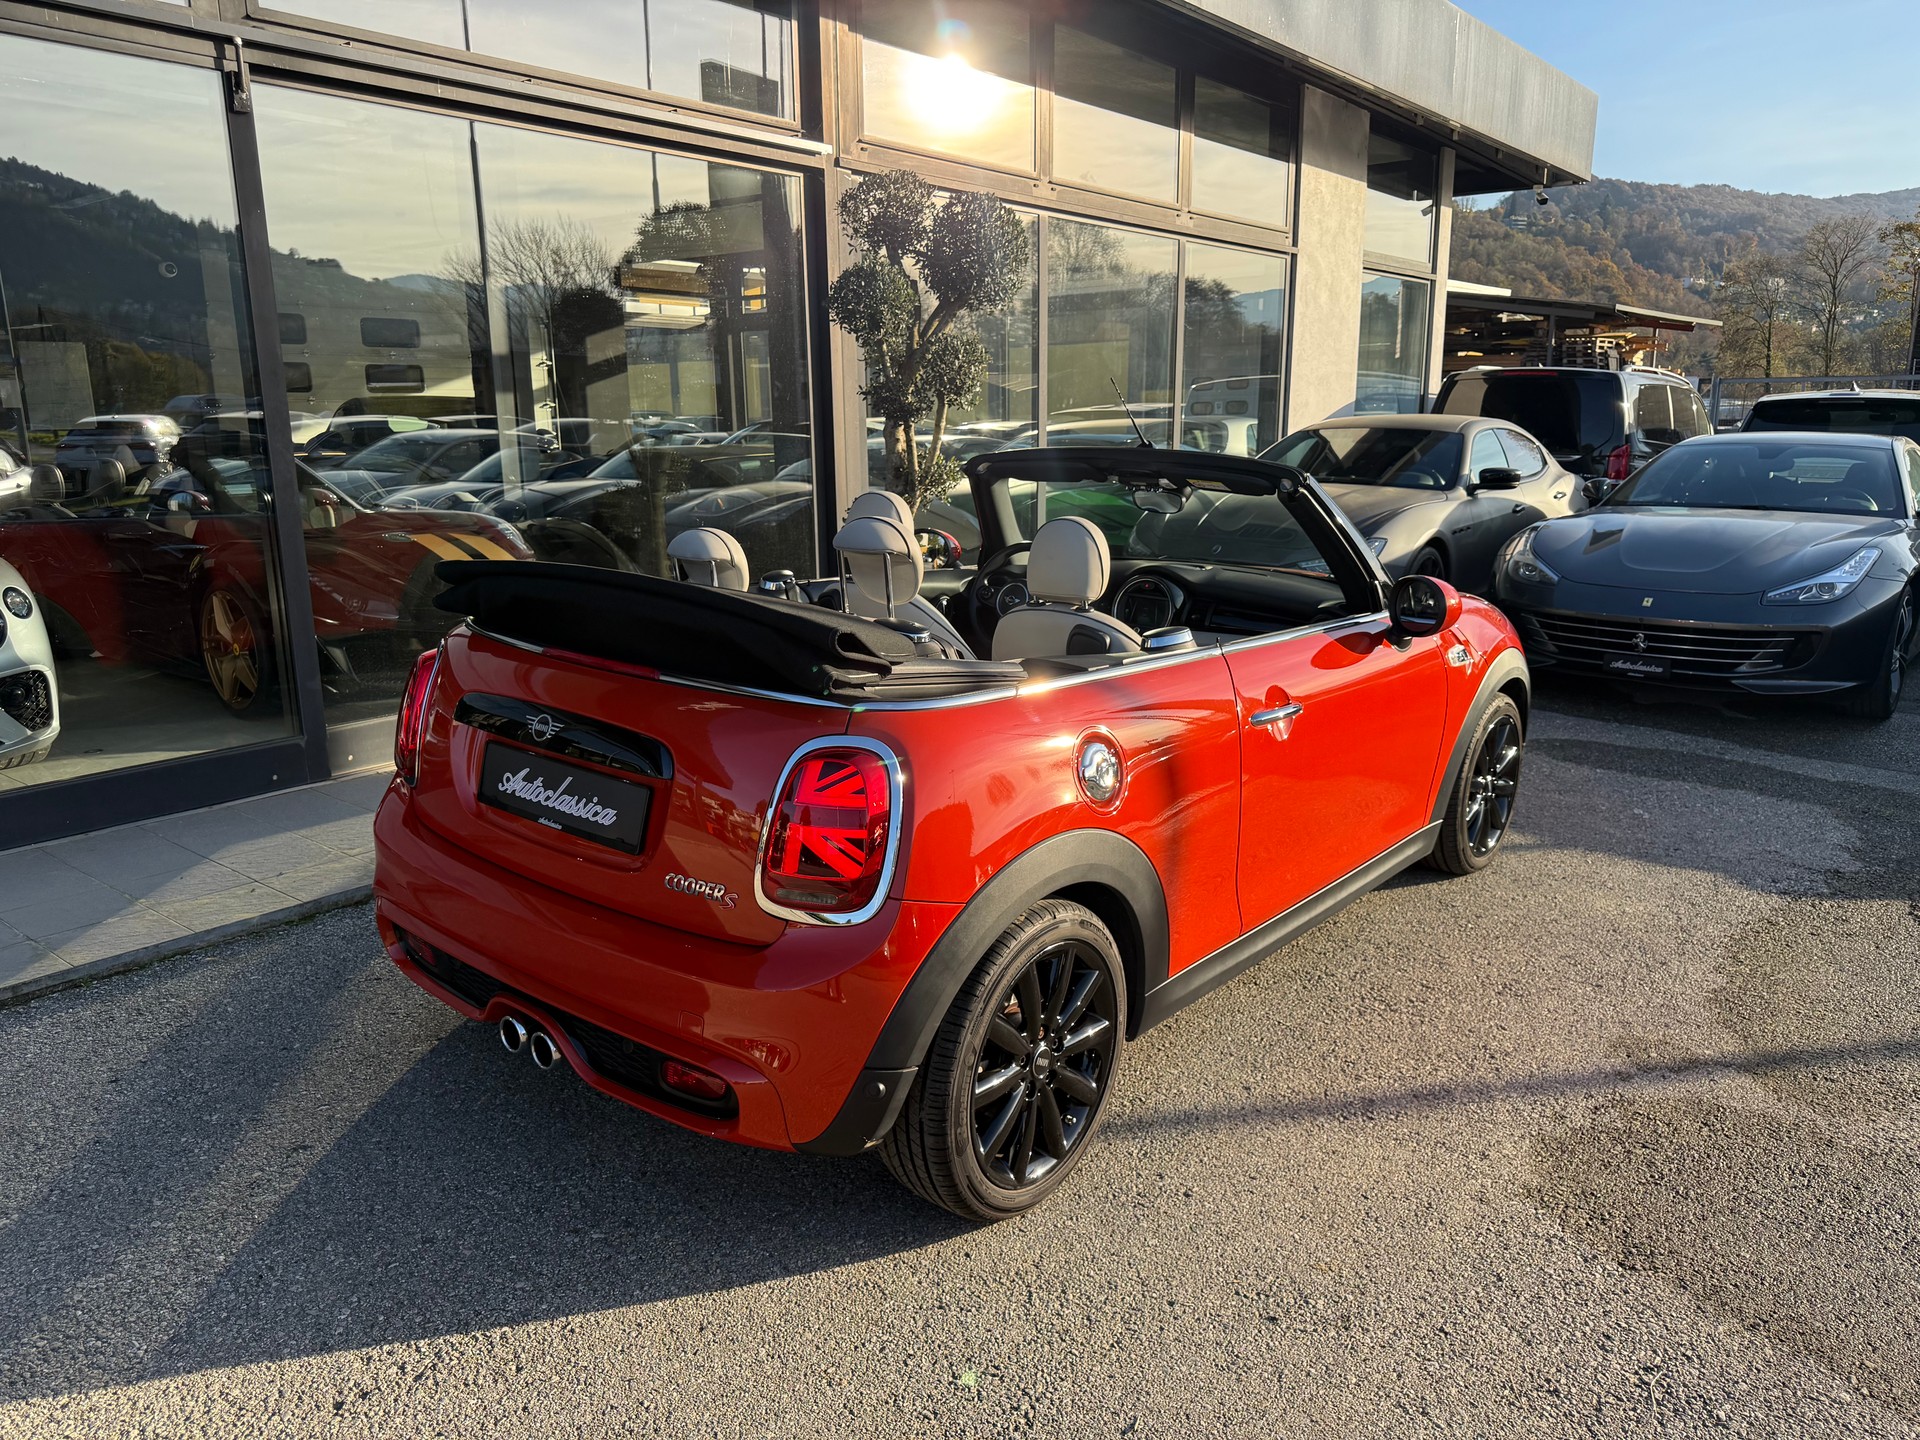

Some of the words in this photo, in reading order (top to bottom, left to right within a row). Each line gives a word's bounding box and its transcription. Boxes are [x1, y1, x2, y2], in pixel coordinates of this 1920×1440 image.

[534, 722, 549, 732] MINI
[498, 767, 617, 826] Autoclassica
[664, 872, 725, 903] COOPER
[718, 893, 739, 910] S
